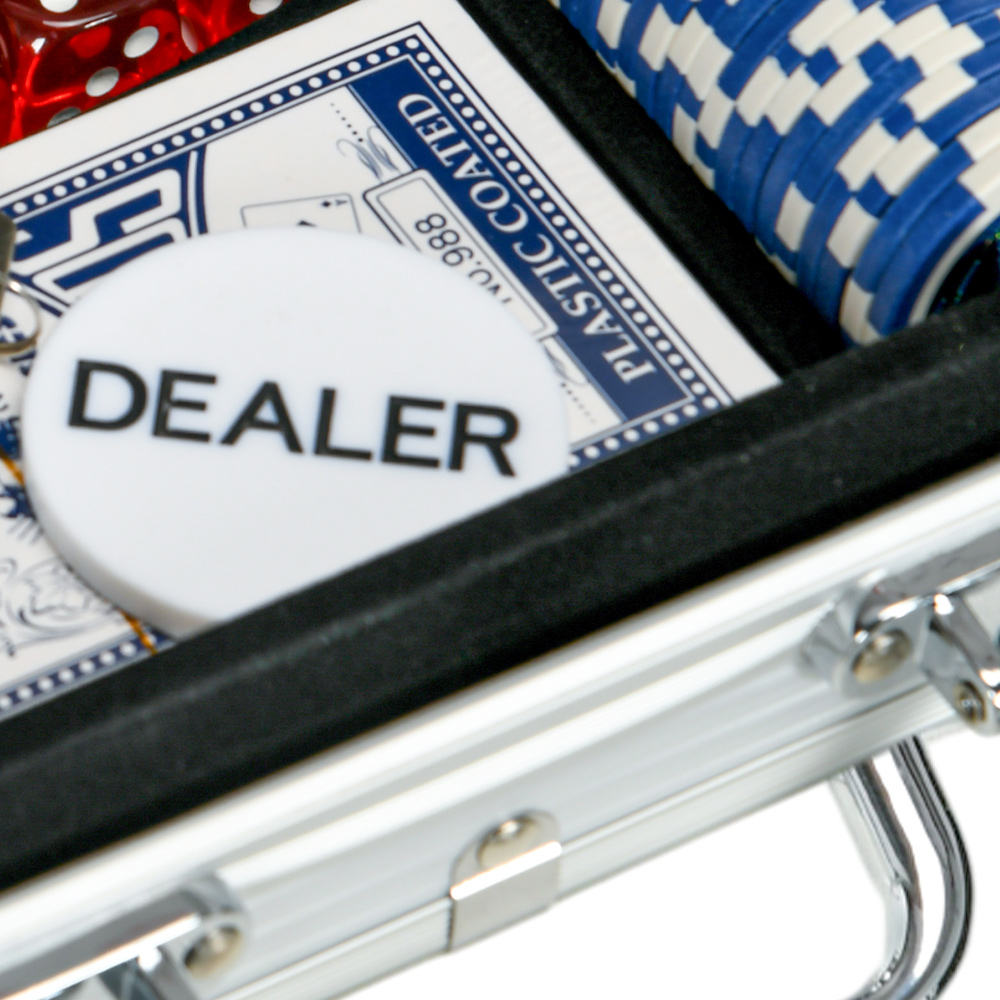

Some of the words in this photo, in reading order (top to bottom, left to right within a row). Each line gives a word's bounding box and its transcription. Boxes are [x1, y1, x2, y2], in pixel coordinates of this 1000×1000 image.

[397, 93, 529, 233] COATED
[511, 233, 657, 384] PLASTIC
[66, 358, 520, 478] DEALER
